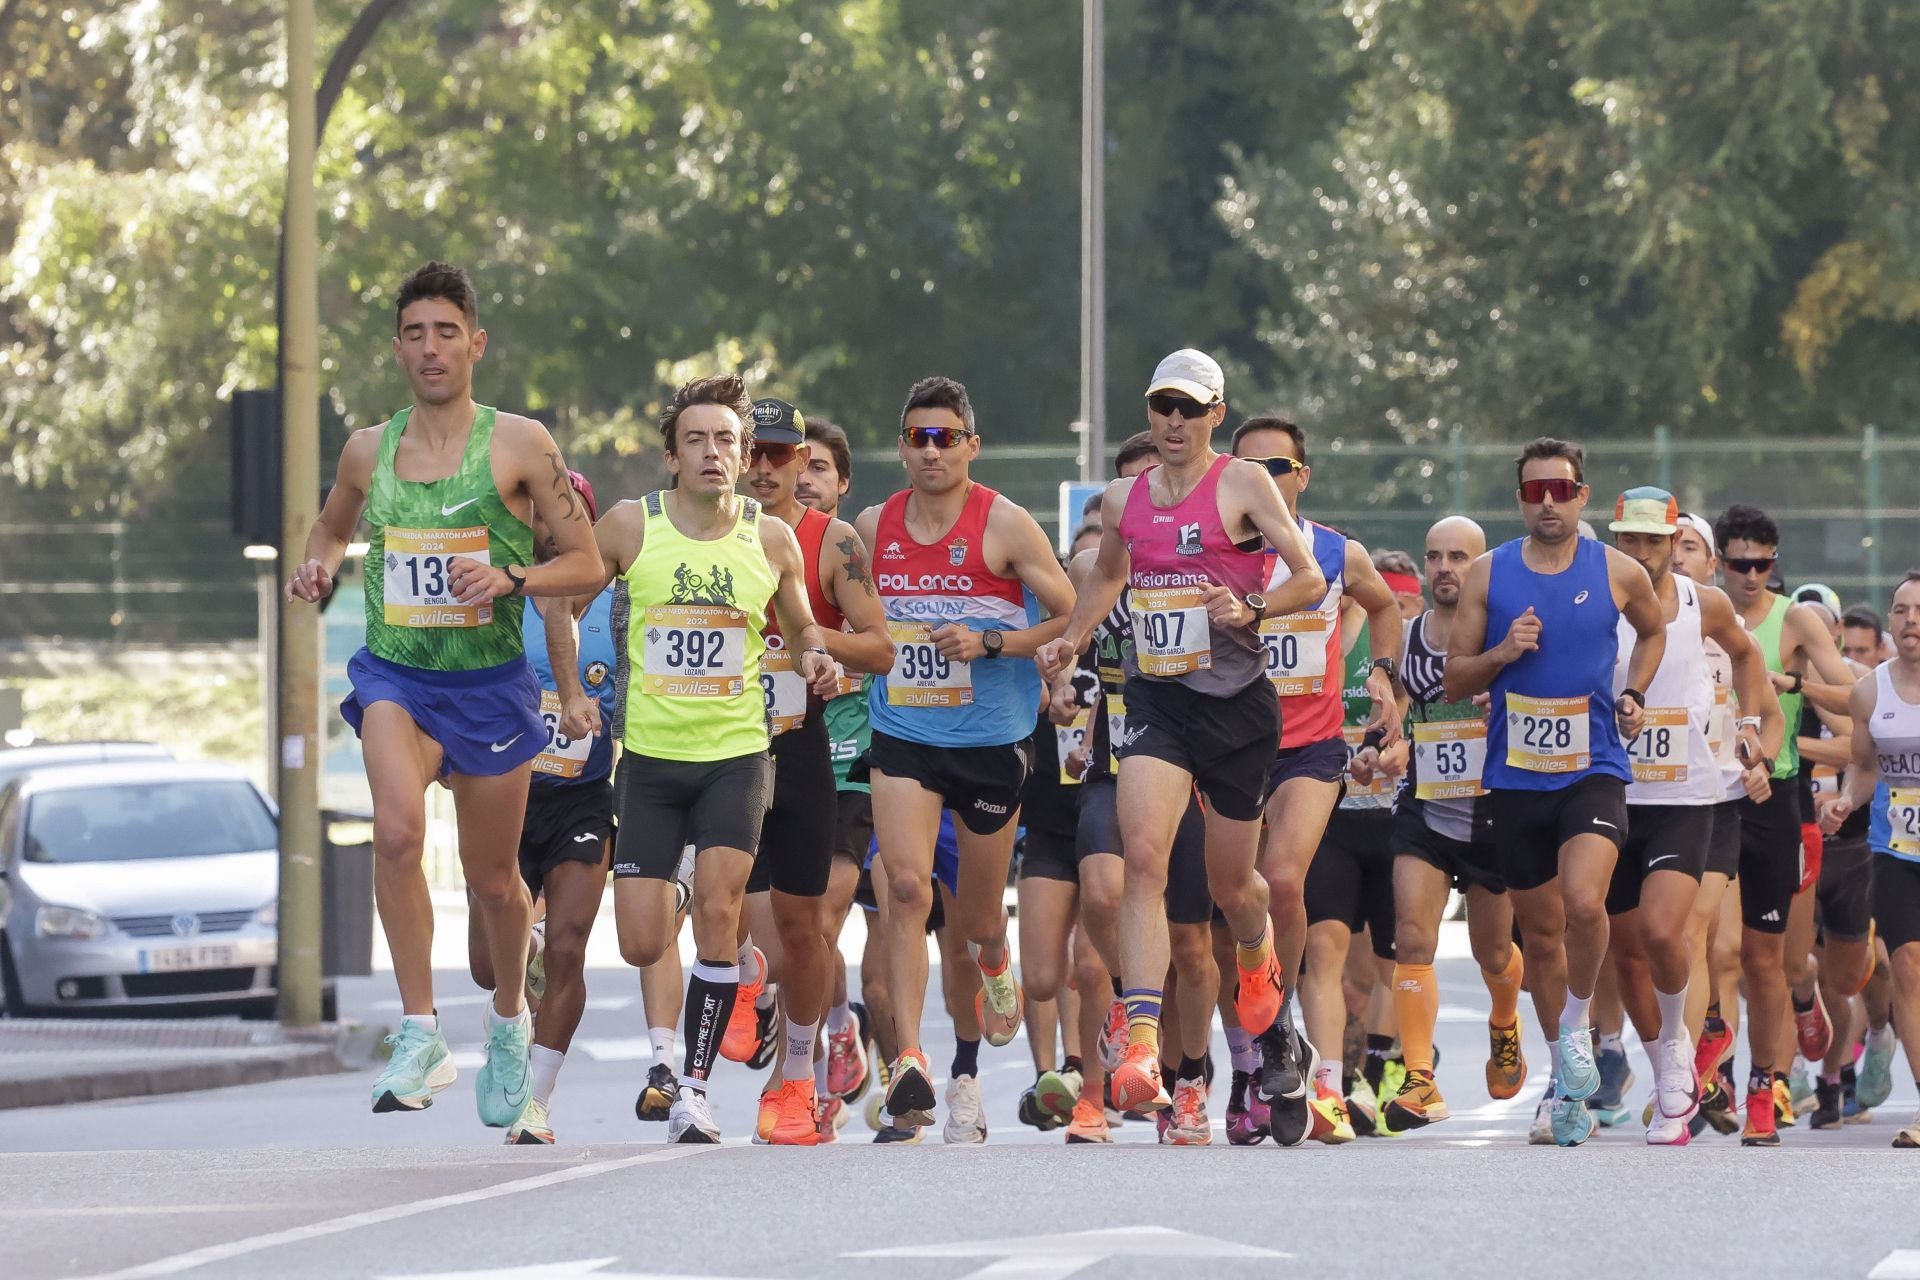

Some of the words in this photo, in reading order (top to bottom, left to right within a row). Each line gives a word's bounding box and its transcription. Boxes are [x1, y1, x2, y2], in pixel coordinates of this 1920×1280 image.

[461, 529, 486, 539] AVILÉS
[421, 543, 445, 551] 2024
[904, 601, 966, 615] SOLVAY
[686, 617, 708, 625] 2024
[1143, 611, 1186, 649] 407
[666, 629, 725, 668] 392
[684, 668, 706, 676] LOZANO
[901, 644, 950, 680] 399
[1523, 716, 1571, 748] 228
[1626, 728, 1670, 758] 218
[1436, 742, 1467, 775] 53
[973, 798, 1007, 814] Joma
